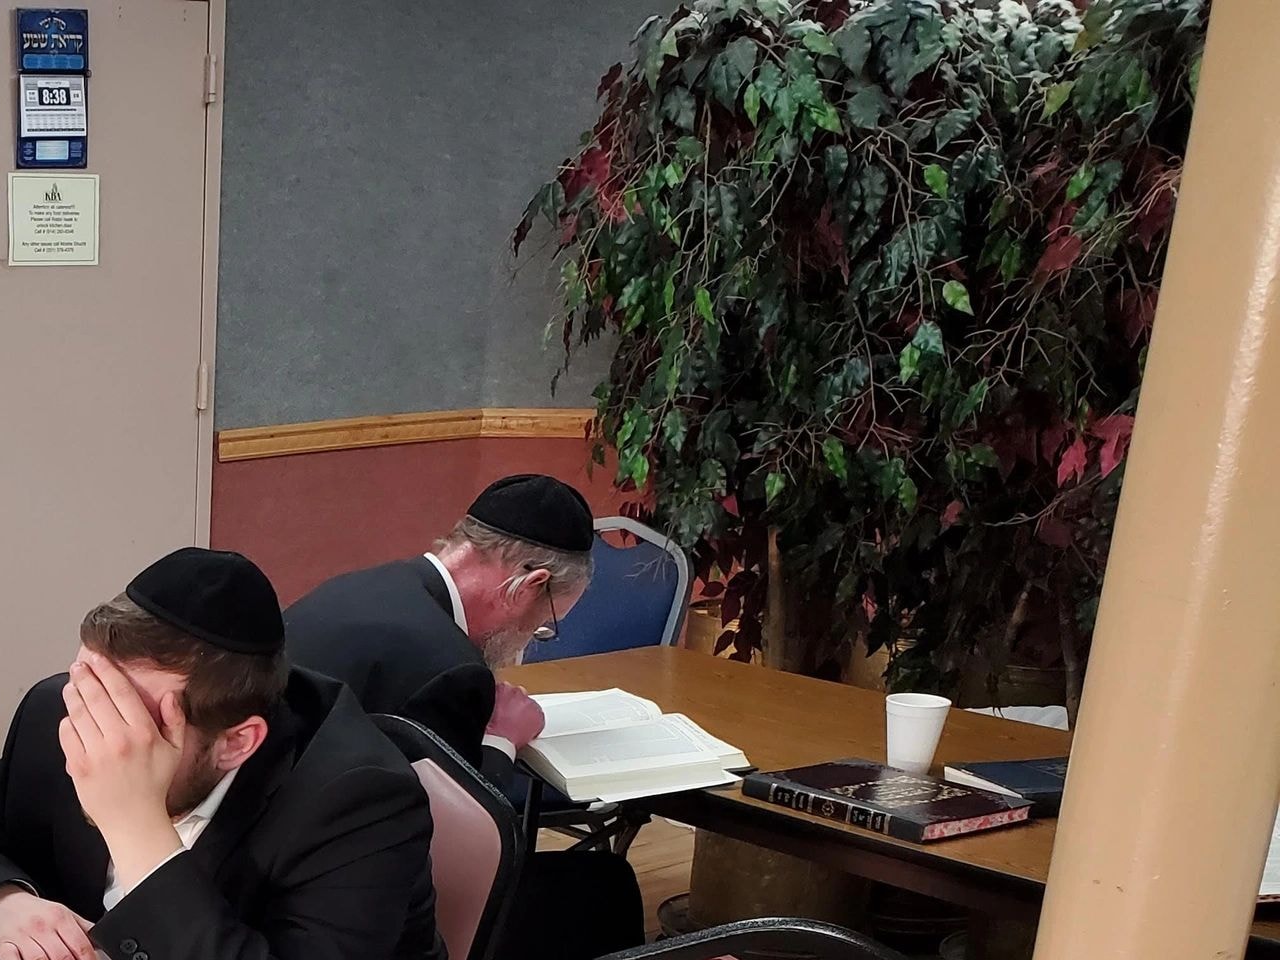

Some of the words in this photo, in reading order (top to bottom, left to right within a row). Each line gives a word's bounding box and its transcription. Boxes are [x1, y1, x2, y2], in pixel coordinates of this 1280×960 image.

[23, 33, 48, 49] שמע
[51, 33, 83, 53] קריאת
[42, 89, 66, 104] 8:38
